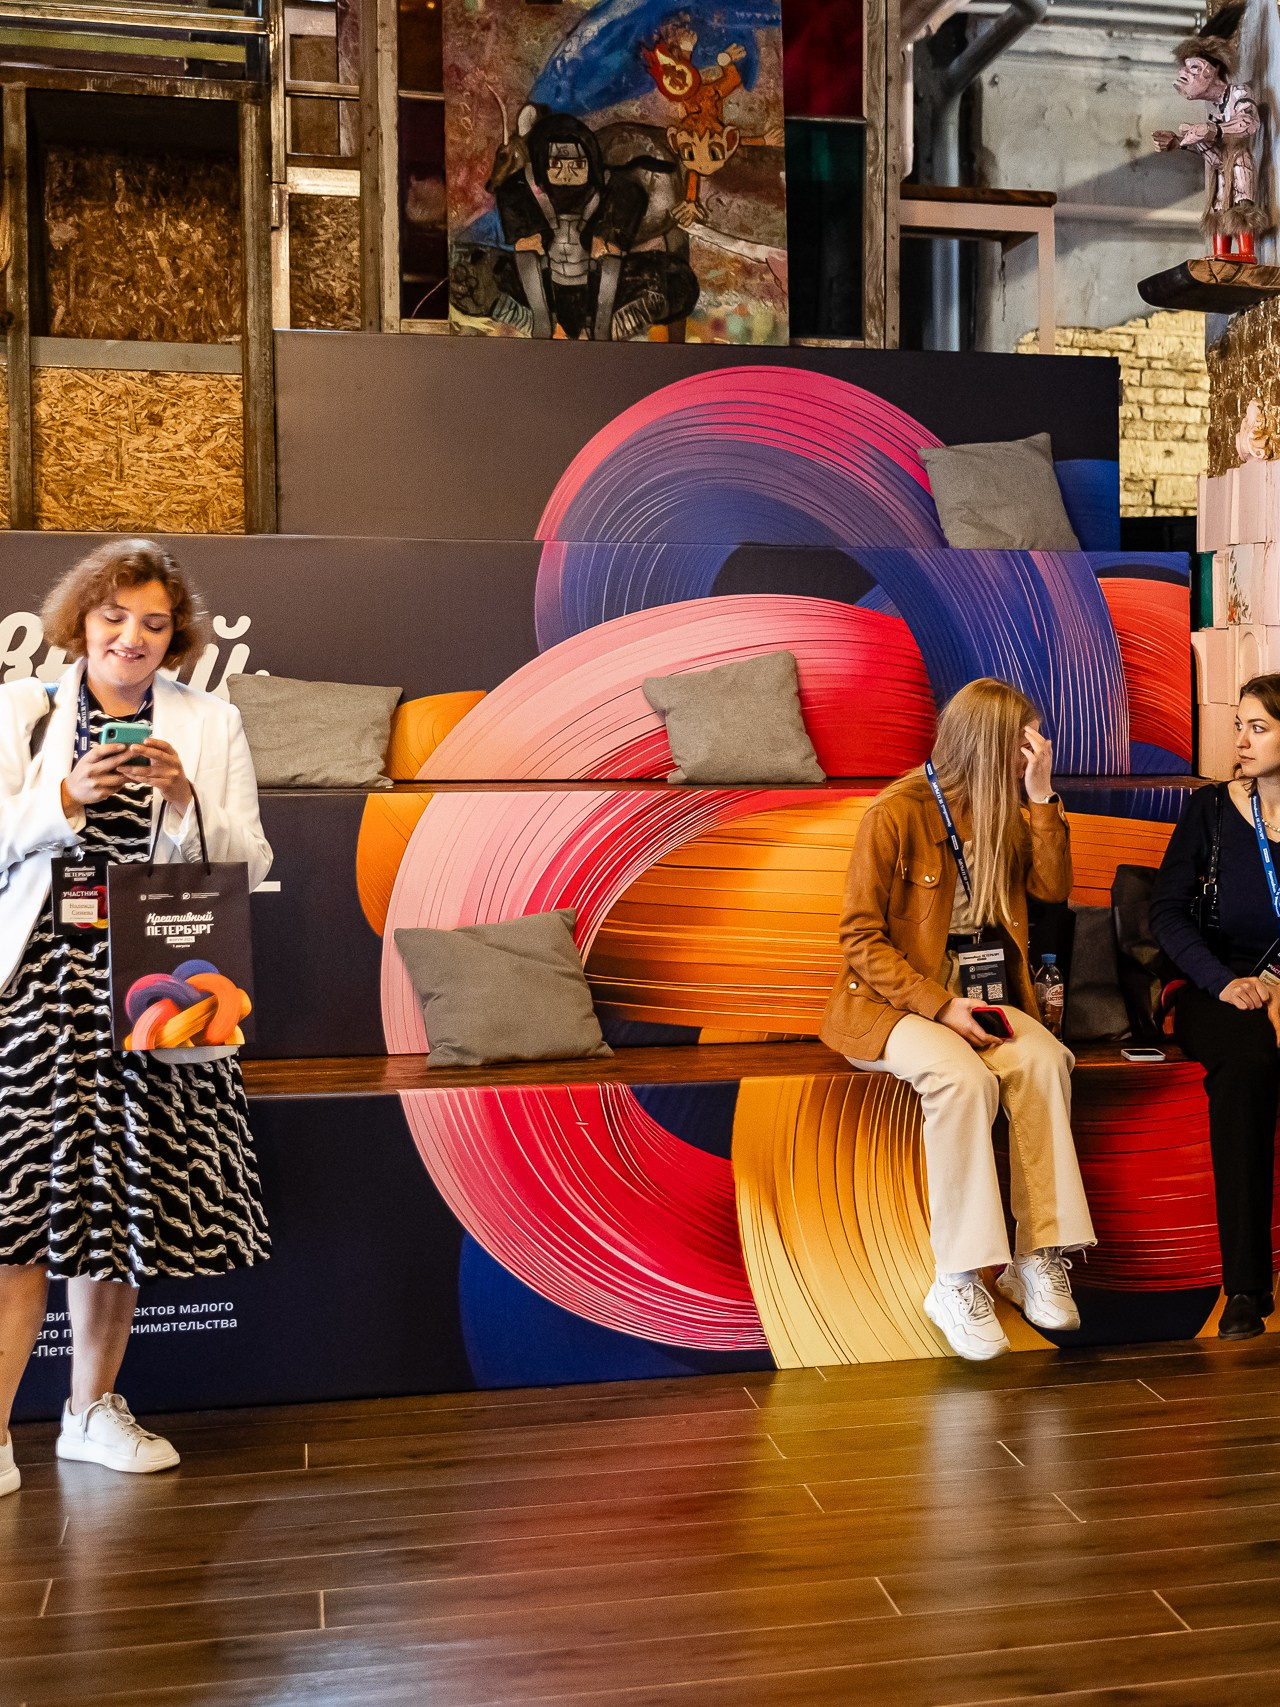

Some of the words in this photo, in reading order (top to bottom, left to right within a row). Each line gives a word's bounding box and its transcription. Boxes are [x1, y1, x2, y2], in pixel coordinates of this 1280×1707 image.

[146, 911, 214, 925] Креативный
[146, 924, 214, 936] ПЕТЕРБУРГ
[133, 1304, 176, 1317] ектов
[179, 1301, 235, 1315] малого
